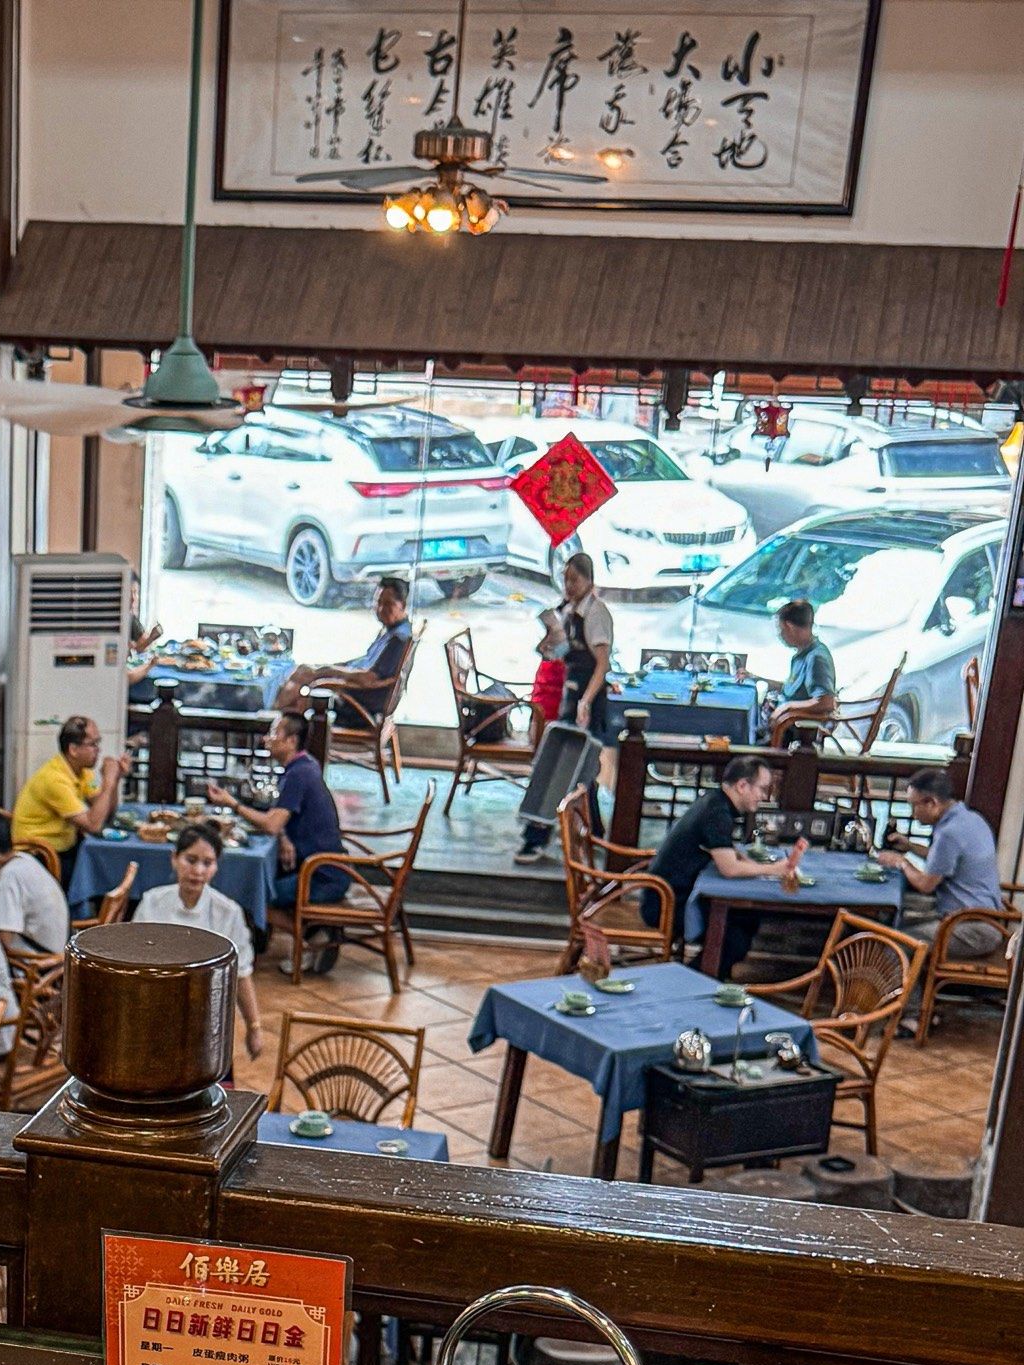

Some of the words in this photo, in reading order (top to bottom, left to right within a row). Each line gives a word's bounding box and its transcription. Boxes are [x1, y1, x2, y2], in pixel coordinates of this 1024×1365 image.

[179, 1252, 270, 1287] 佰樂居
[193, 1299, 223, 1310] FRESH
[231, 1304, 257, 1314] DAILY
[259, 1307, 283, 1317] GOLD
[142, 1307, 305, 1349] 日日新鲜日日金
[140, 1340, 174, 1353] 星期一
[192, 1348, 249, 1364] 皮蛋瘦肉粥
